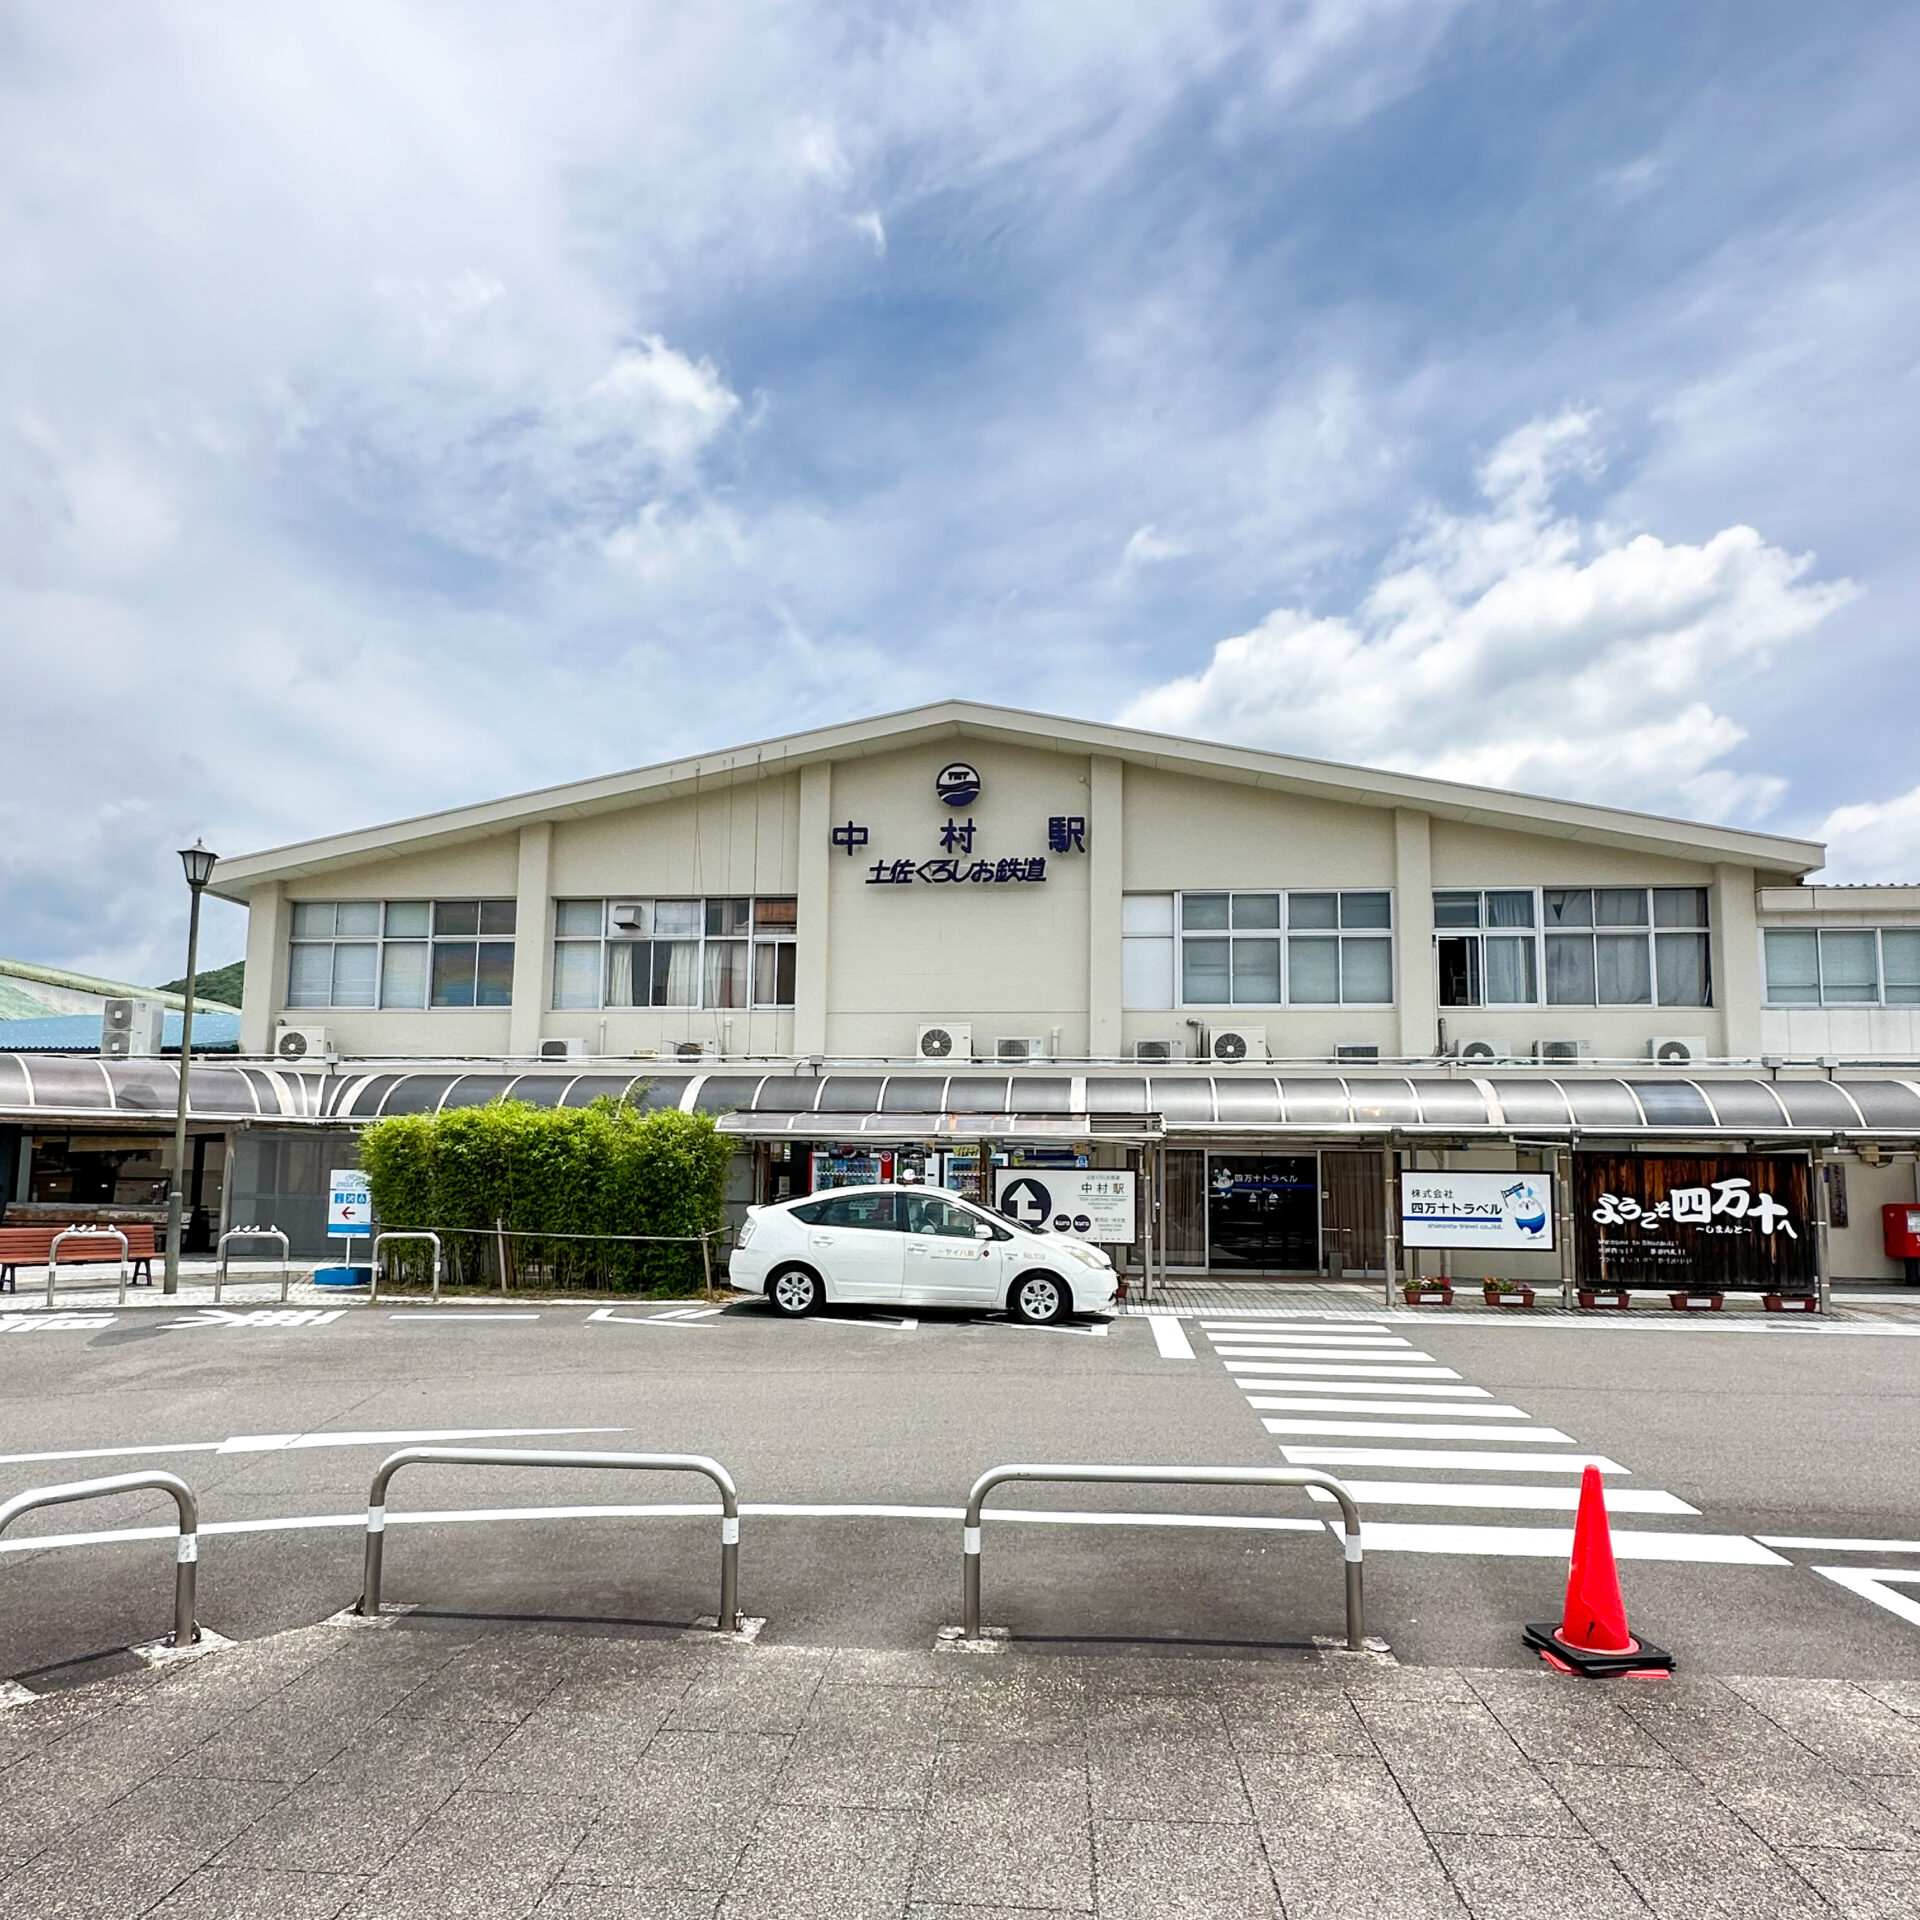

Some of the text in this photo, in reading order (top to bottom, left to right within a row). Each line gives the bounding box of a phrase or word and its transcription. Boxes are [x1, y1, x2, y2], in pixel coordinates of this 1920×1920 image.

[865, 857, 1047, 885] 土佐くろしお鉄道
[1234, 1174, 1298, 1183] 四万十トラベル
[1081, 1182, 1125, 1195] 中村駅
[1411, 1189, 1454, 1199] 株式会社
[1411, 1202, 1503, 1215] 四万十トラベル
